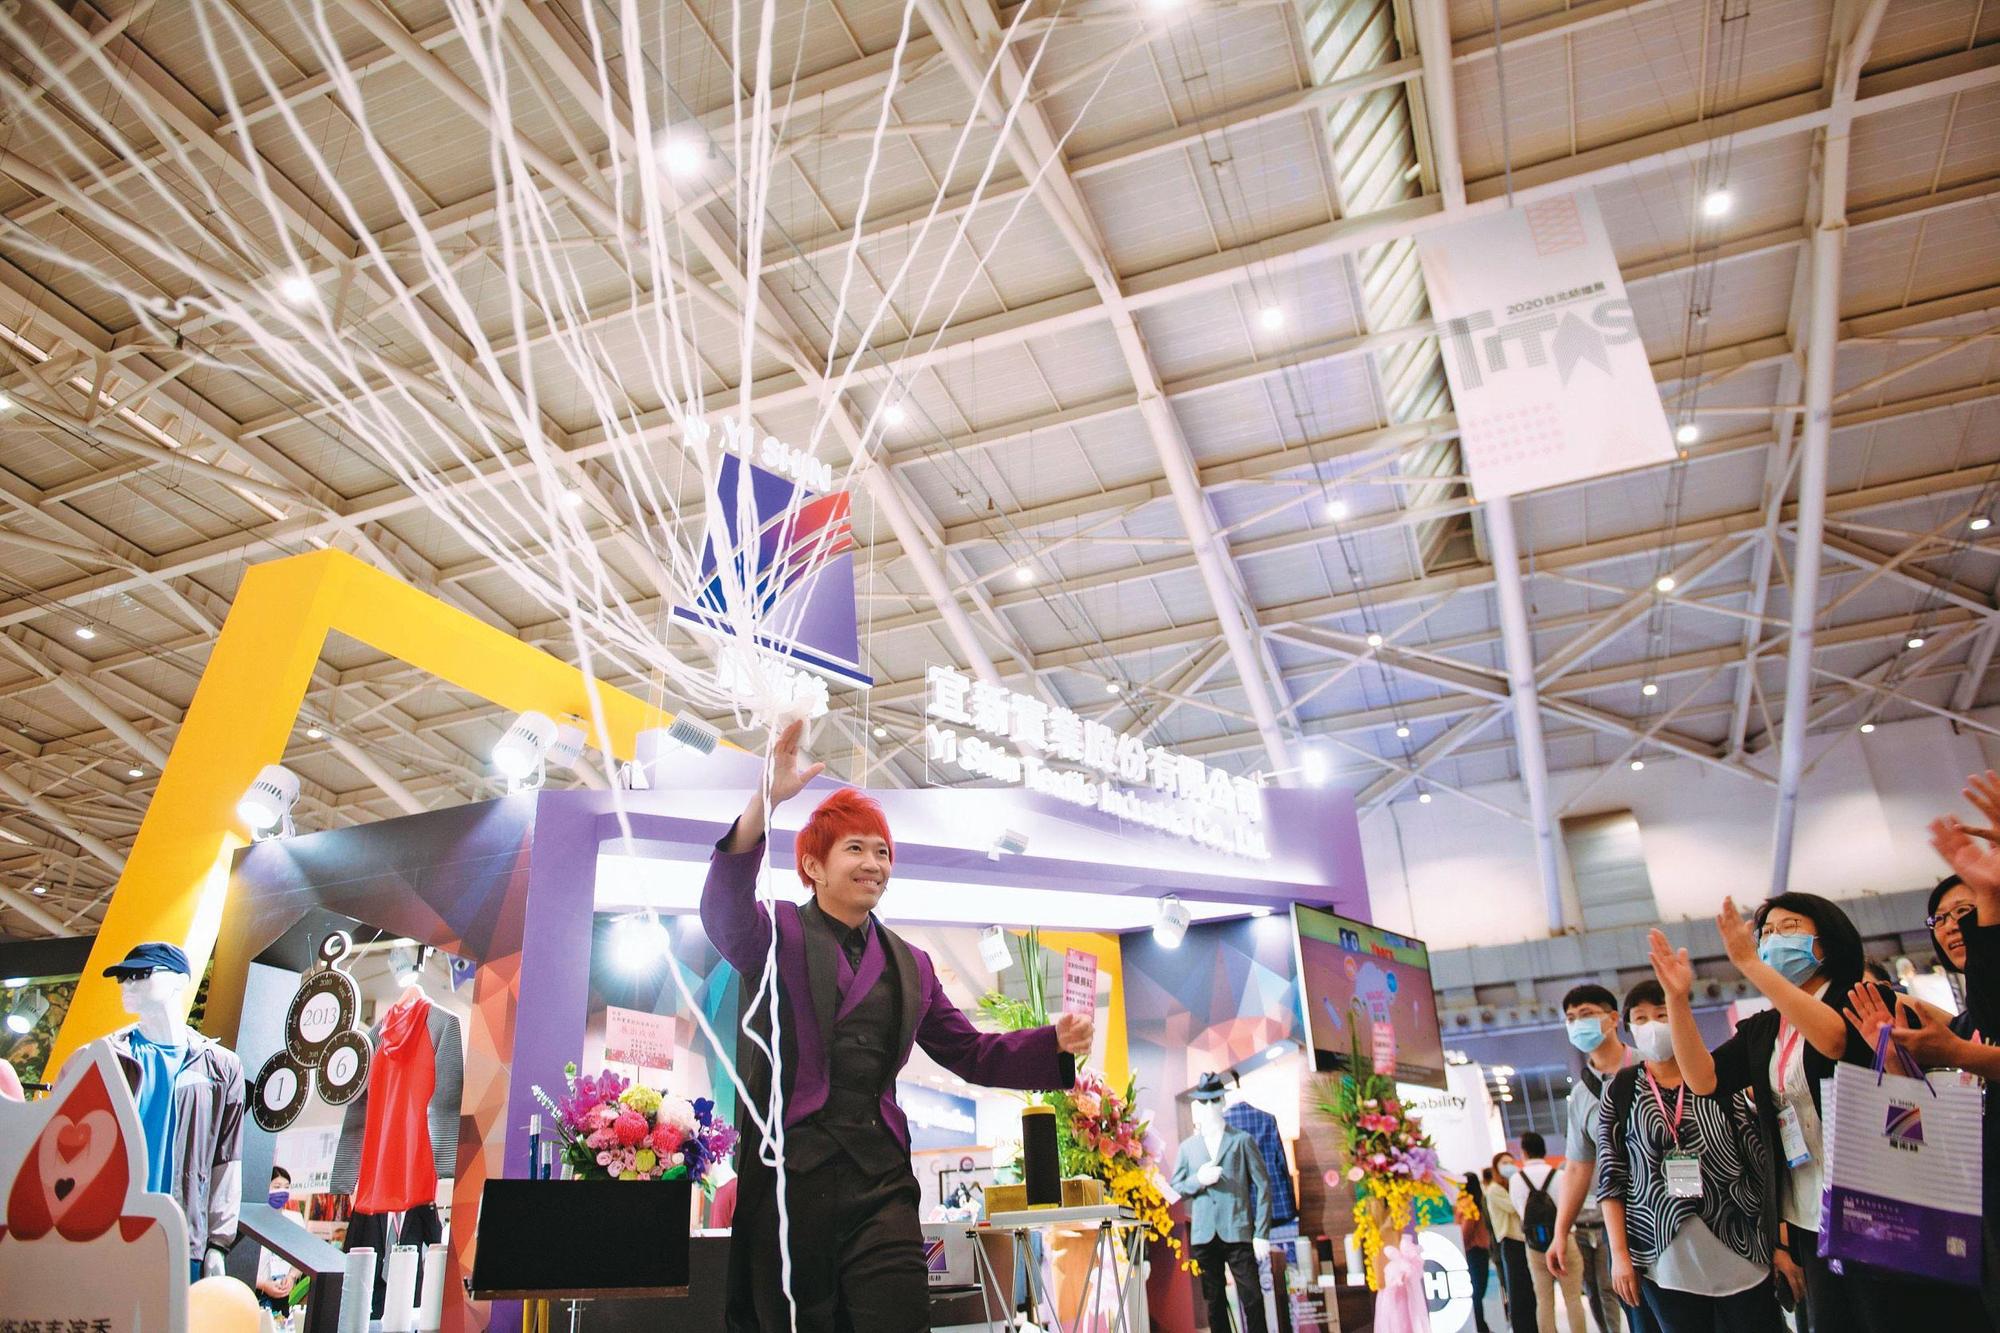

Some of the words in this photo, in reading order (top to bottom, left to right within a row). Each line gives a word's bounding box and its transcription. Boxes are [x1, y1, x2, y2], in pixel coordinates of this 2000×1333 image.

[760, 435, 832, 492] SHIN
[926, 724, 957, 764] Yi
[957, 736, 1021, 783] Shin
[1020, 756, 1099, 807] Textile
[302, 1006, 338, 1027] 2013
[336, 1054, 350, 1079] 6
[273, 1076, 284, 1102] 1
